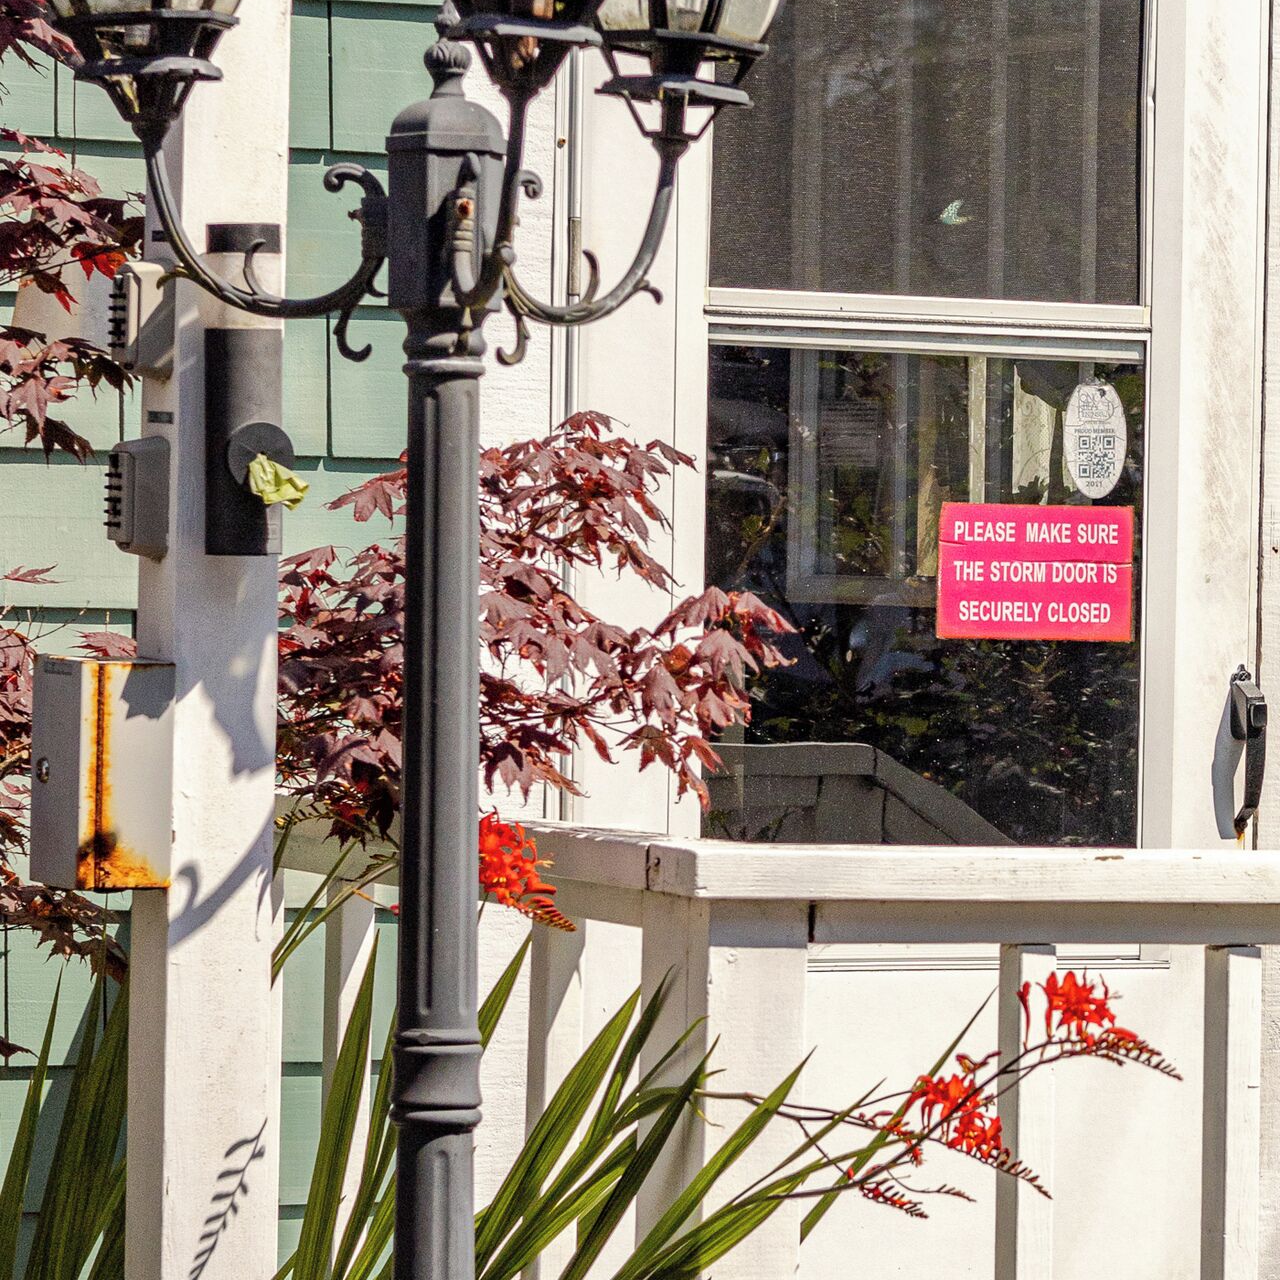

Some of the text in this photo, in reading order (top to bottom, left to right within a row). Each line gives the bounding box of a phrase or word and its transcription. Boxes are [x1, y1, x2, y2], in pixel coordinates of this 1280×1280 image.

[953, 521, 1119, 545] PLEASE MAKE SURE
[954, 561, 1118, 584] THE STORM DOOR IS
[958, 600, 1111, 623] SECURELY CLOSED
